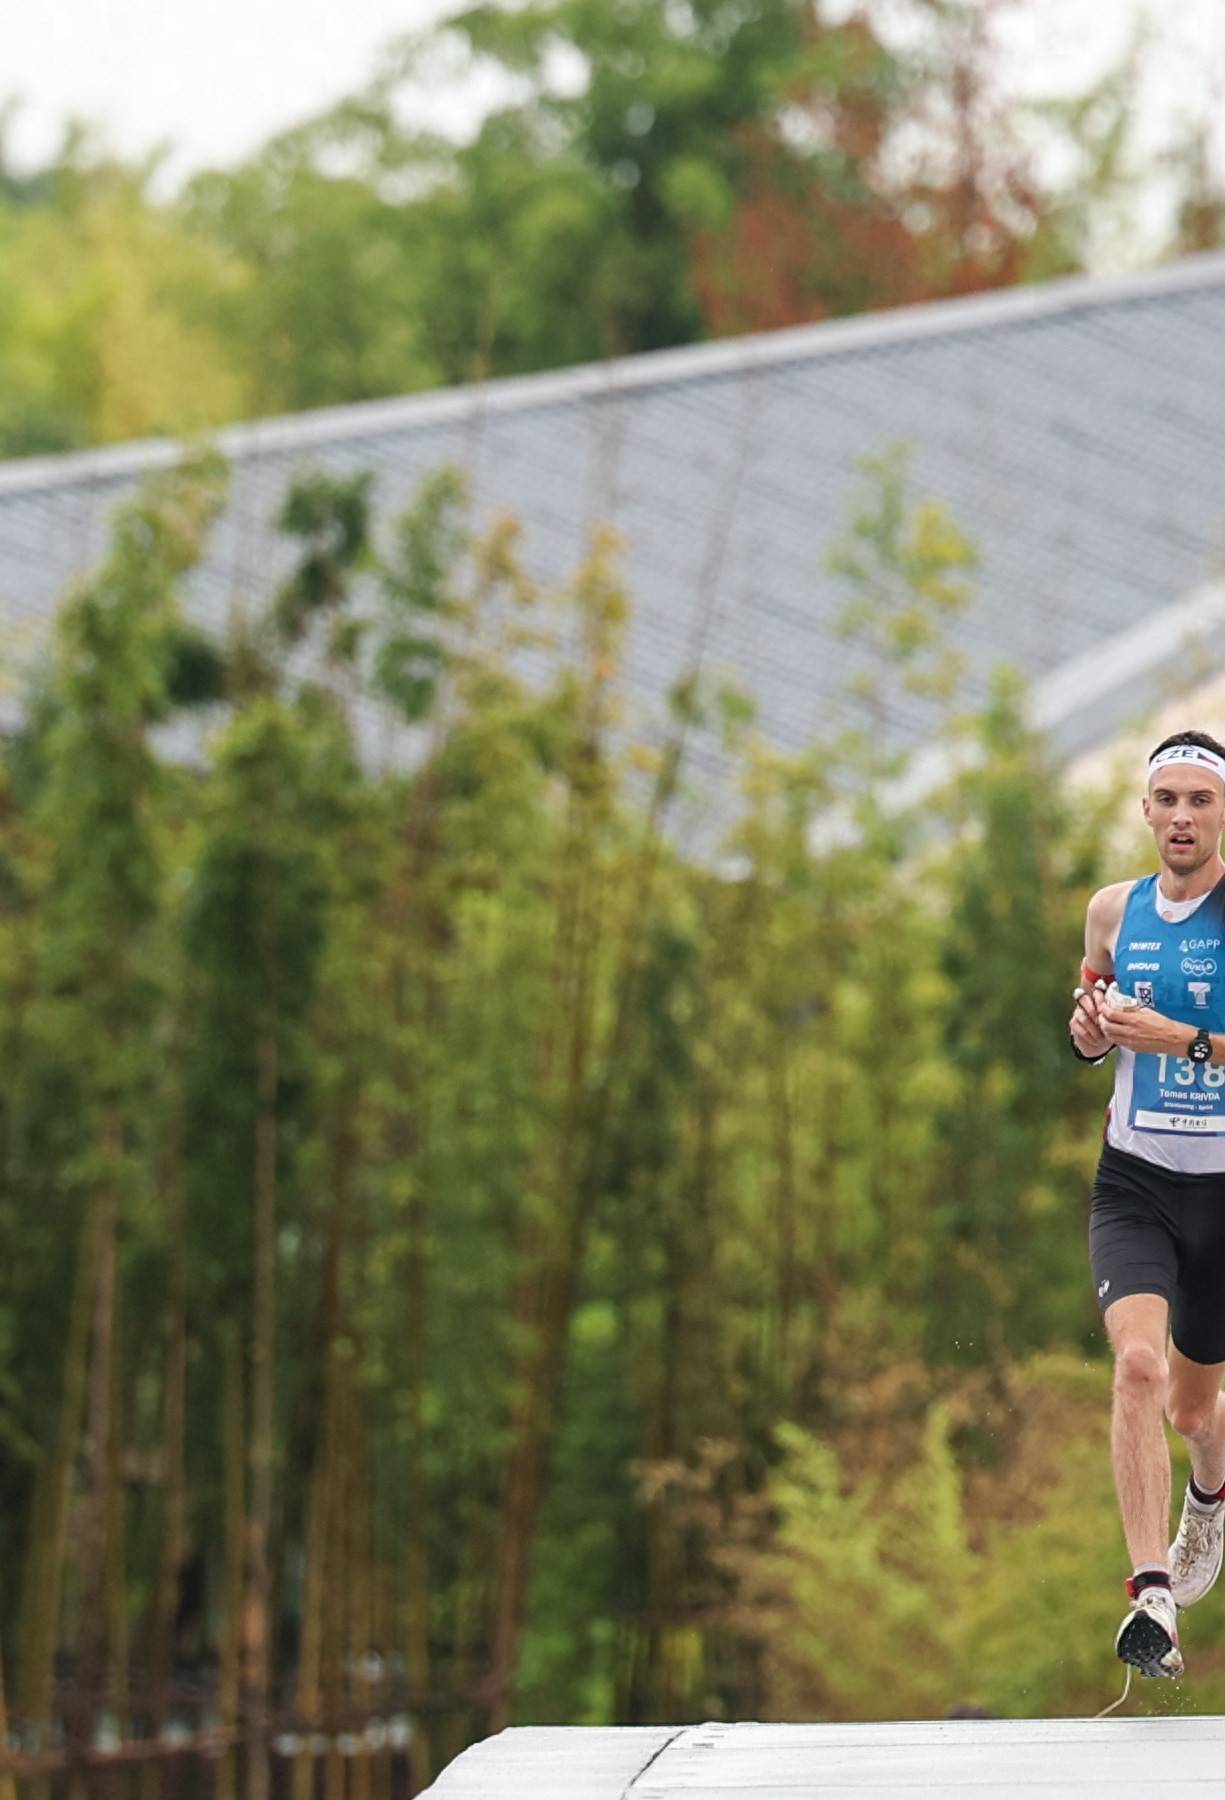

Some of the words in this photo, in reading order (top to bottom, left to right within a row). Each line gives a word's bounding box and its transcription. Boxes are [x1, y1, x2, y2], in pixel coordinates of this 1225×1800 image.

[1156, 750, 1194, 763] CZE
[1189, 939, 1221, 950] GAPP
[1156, 1053, 1225, 1088] 138
[1160, 1088, 1188, 1100] Tomas
